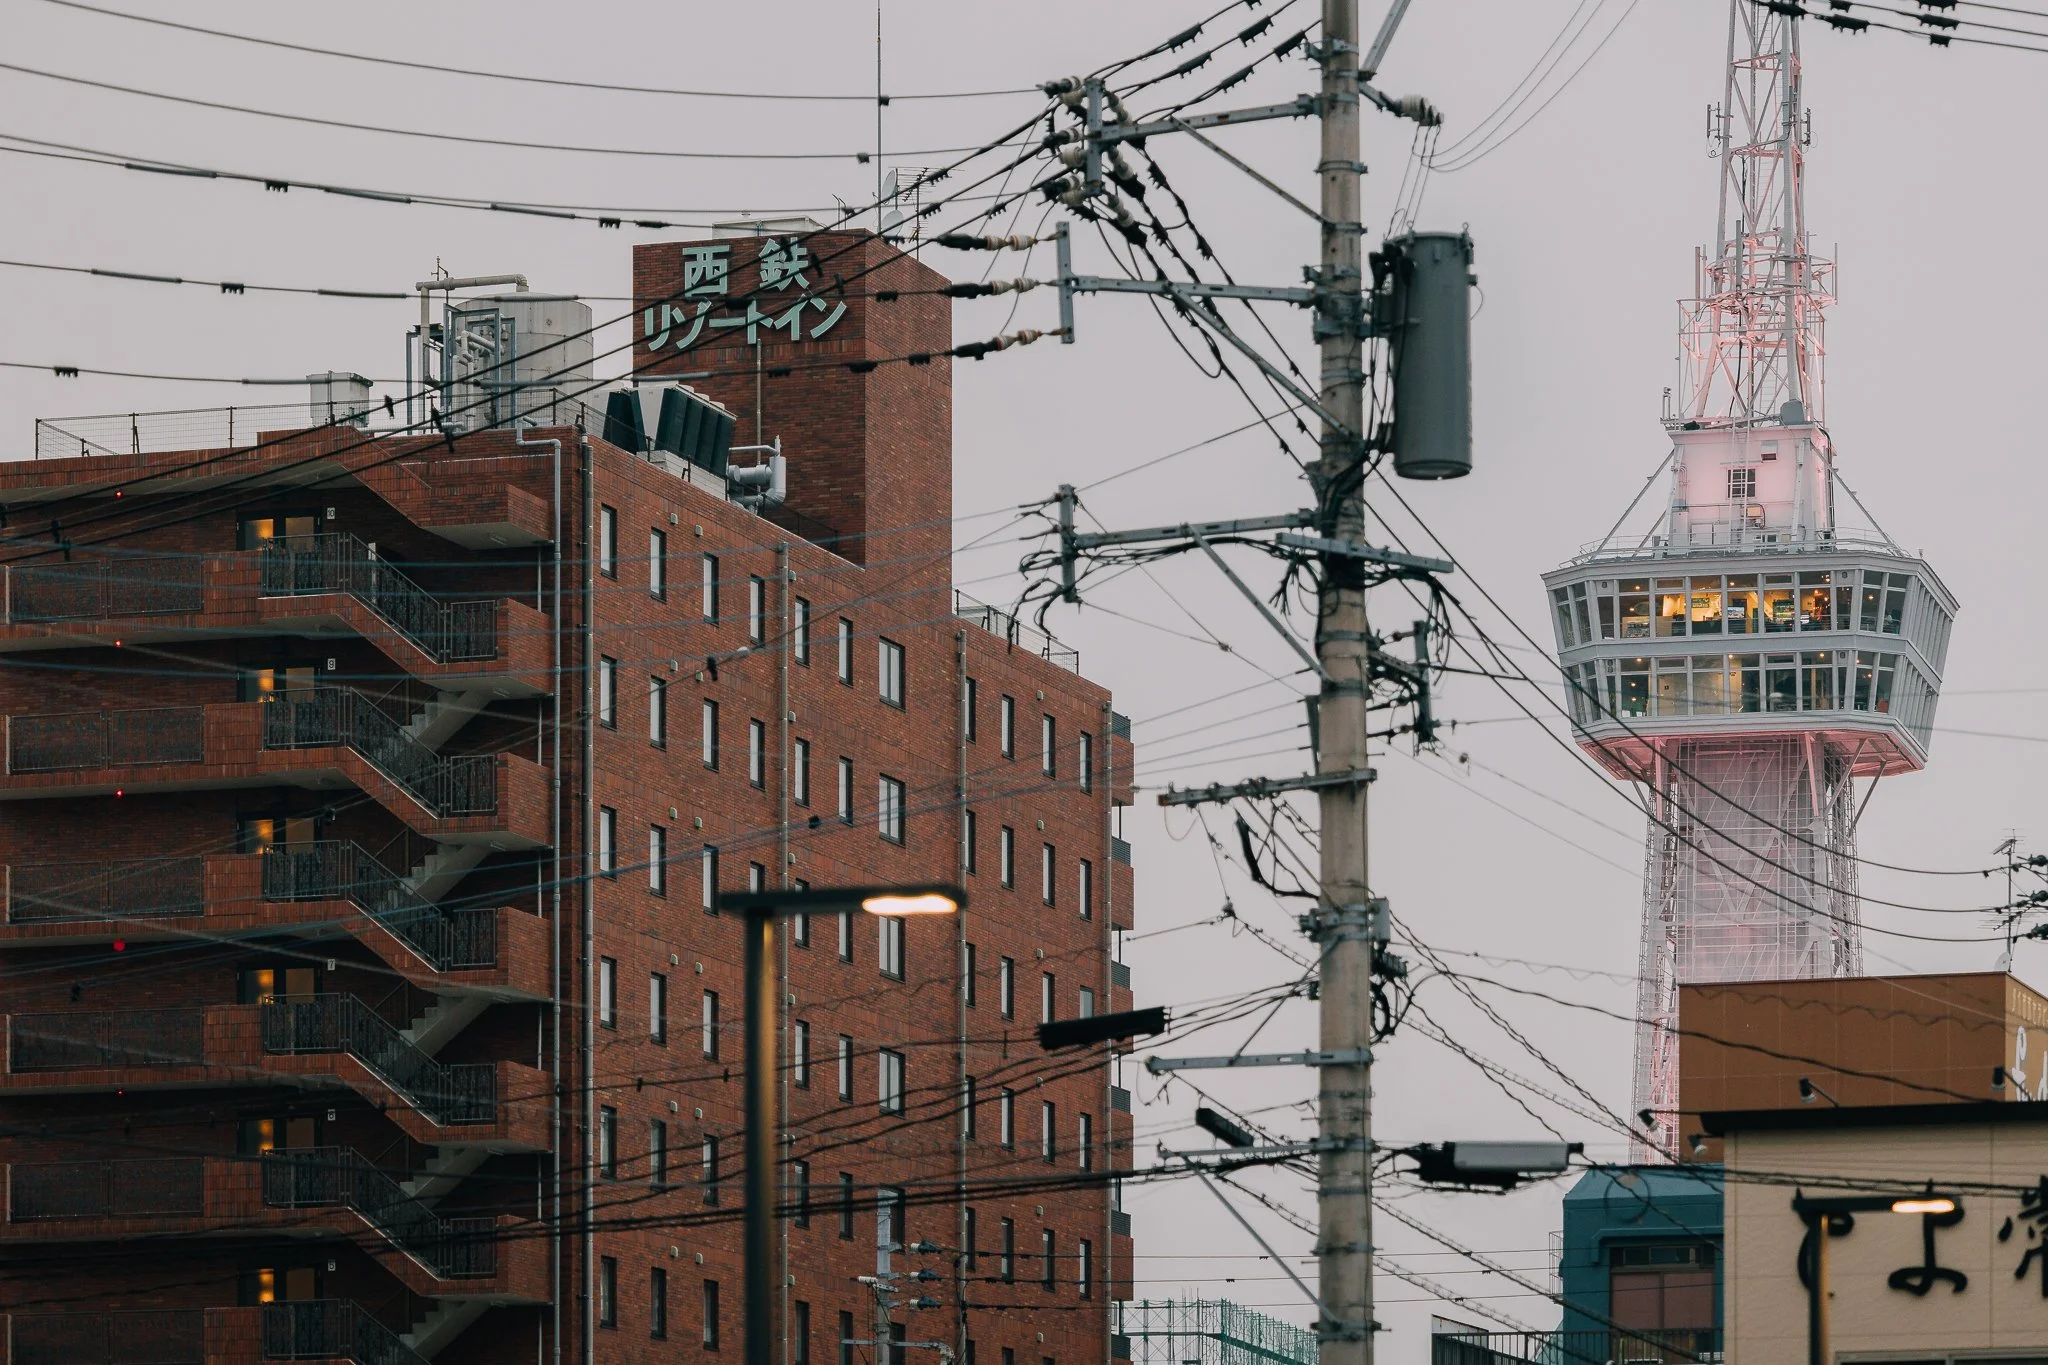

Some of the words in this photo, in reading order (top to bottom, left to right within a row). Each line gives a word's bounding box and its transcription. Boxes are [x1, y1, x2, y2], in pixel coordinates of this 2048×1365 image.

[683, 237, 810, 297] 西鉄
[644, 294, 848, 351] リゾートイン
